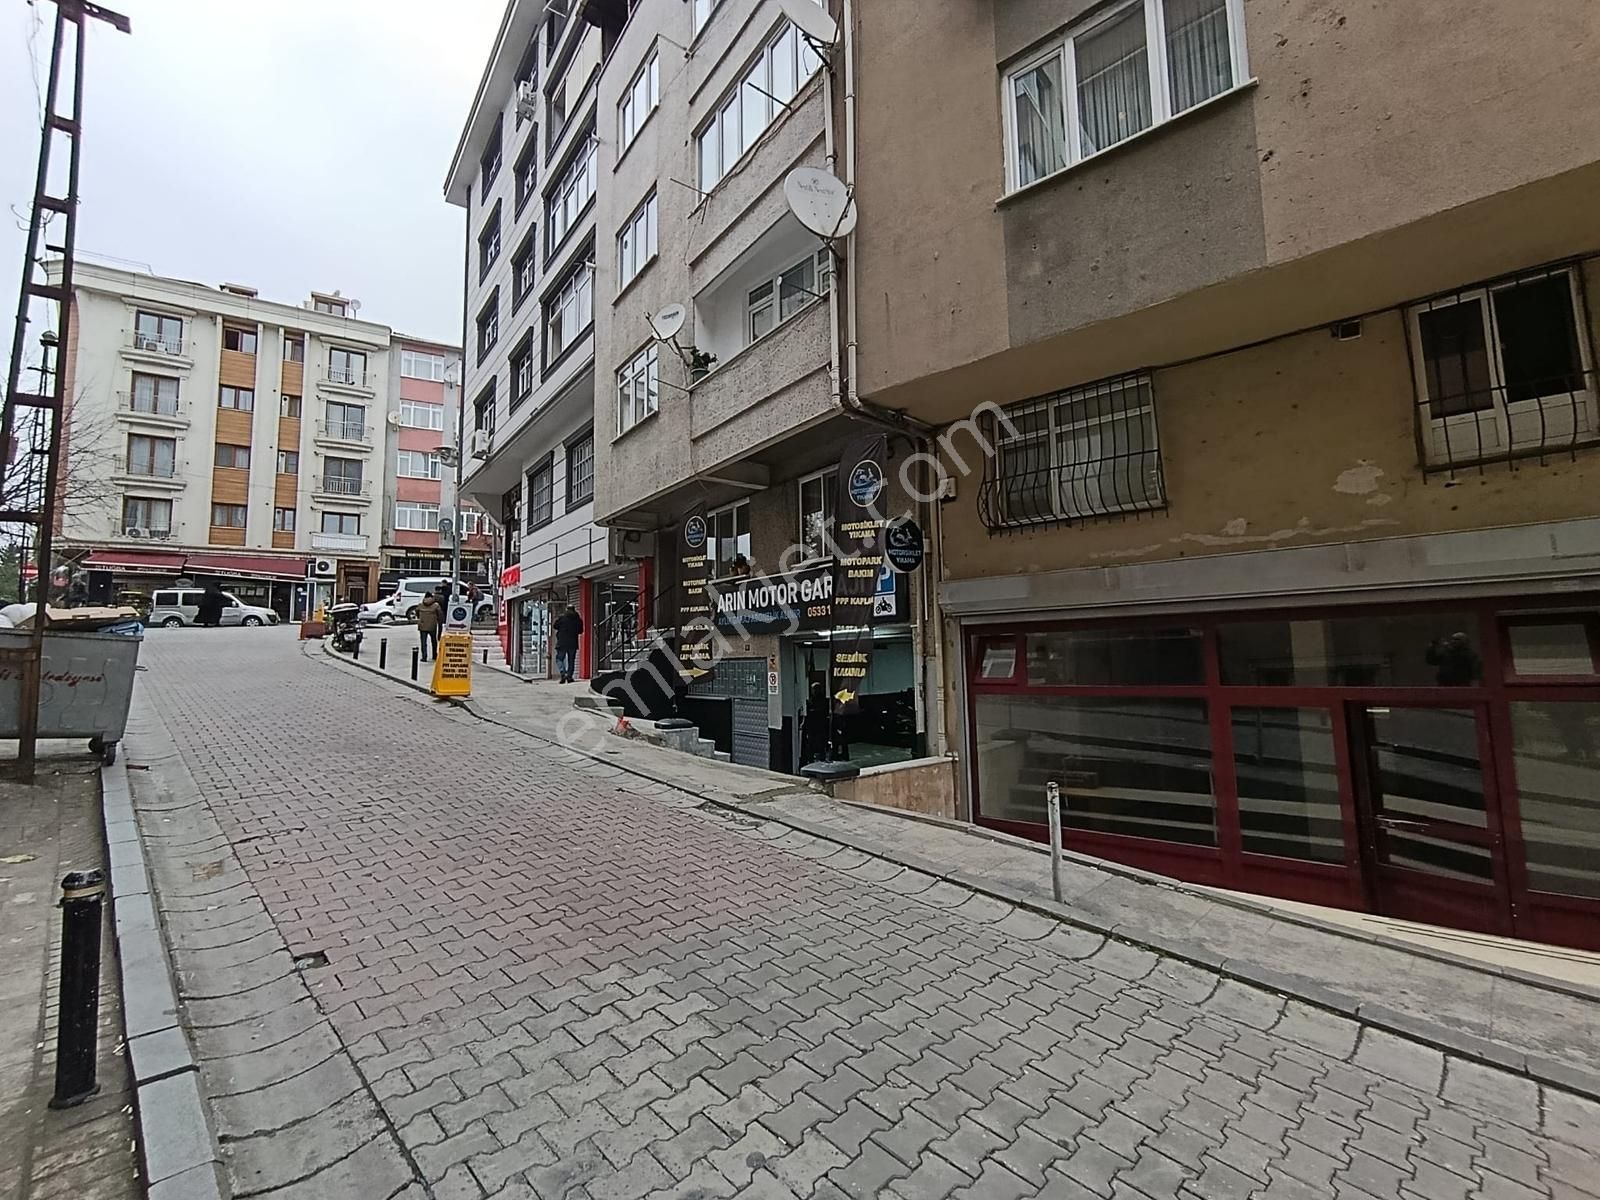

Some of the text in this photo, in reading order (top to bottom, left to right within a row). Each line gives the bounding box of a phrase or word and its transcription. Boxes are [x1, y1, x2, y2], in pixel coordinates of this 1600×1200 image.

[848, 529, 876, 539] YIKAMA
[840, 556, 882, 566] MOTOPARK
[847, 569, 874, 578] BAKIM
[717, 590, 746, 613] ARIN
[748, 582, 798, 609] MOTOR
[807, 606, 826, 617] 0533
